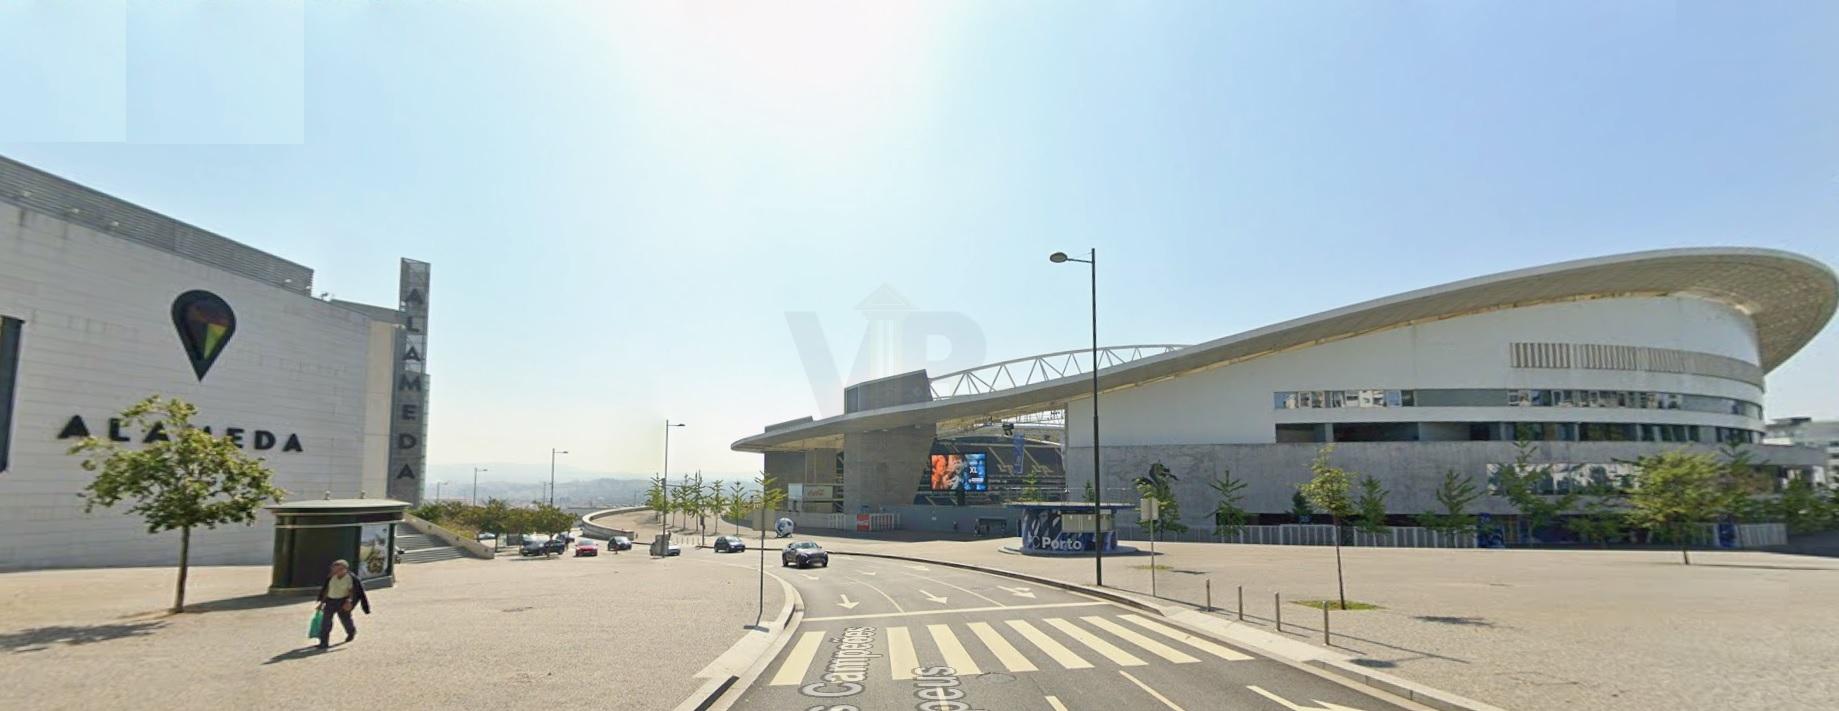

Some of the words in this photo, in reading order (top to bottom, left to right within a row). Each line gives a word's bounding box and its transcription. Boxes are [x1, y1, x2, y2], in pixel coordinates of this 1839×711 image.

[397, 288, 424, 480] ALAMEDA
[58, 414, 303, 452] ALAEDA
[1042, 537, 1082, 550] Porto
